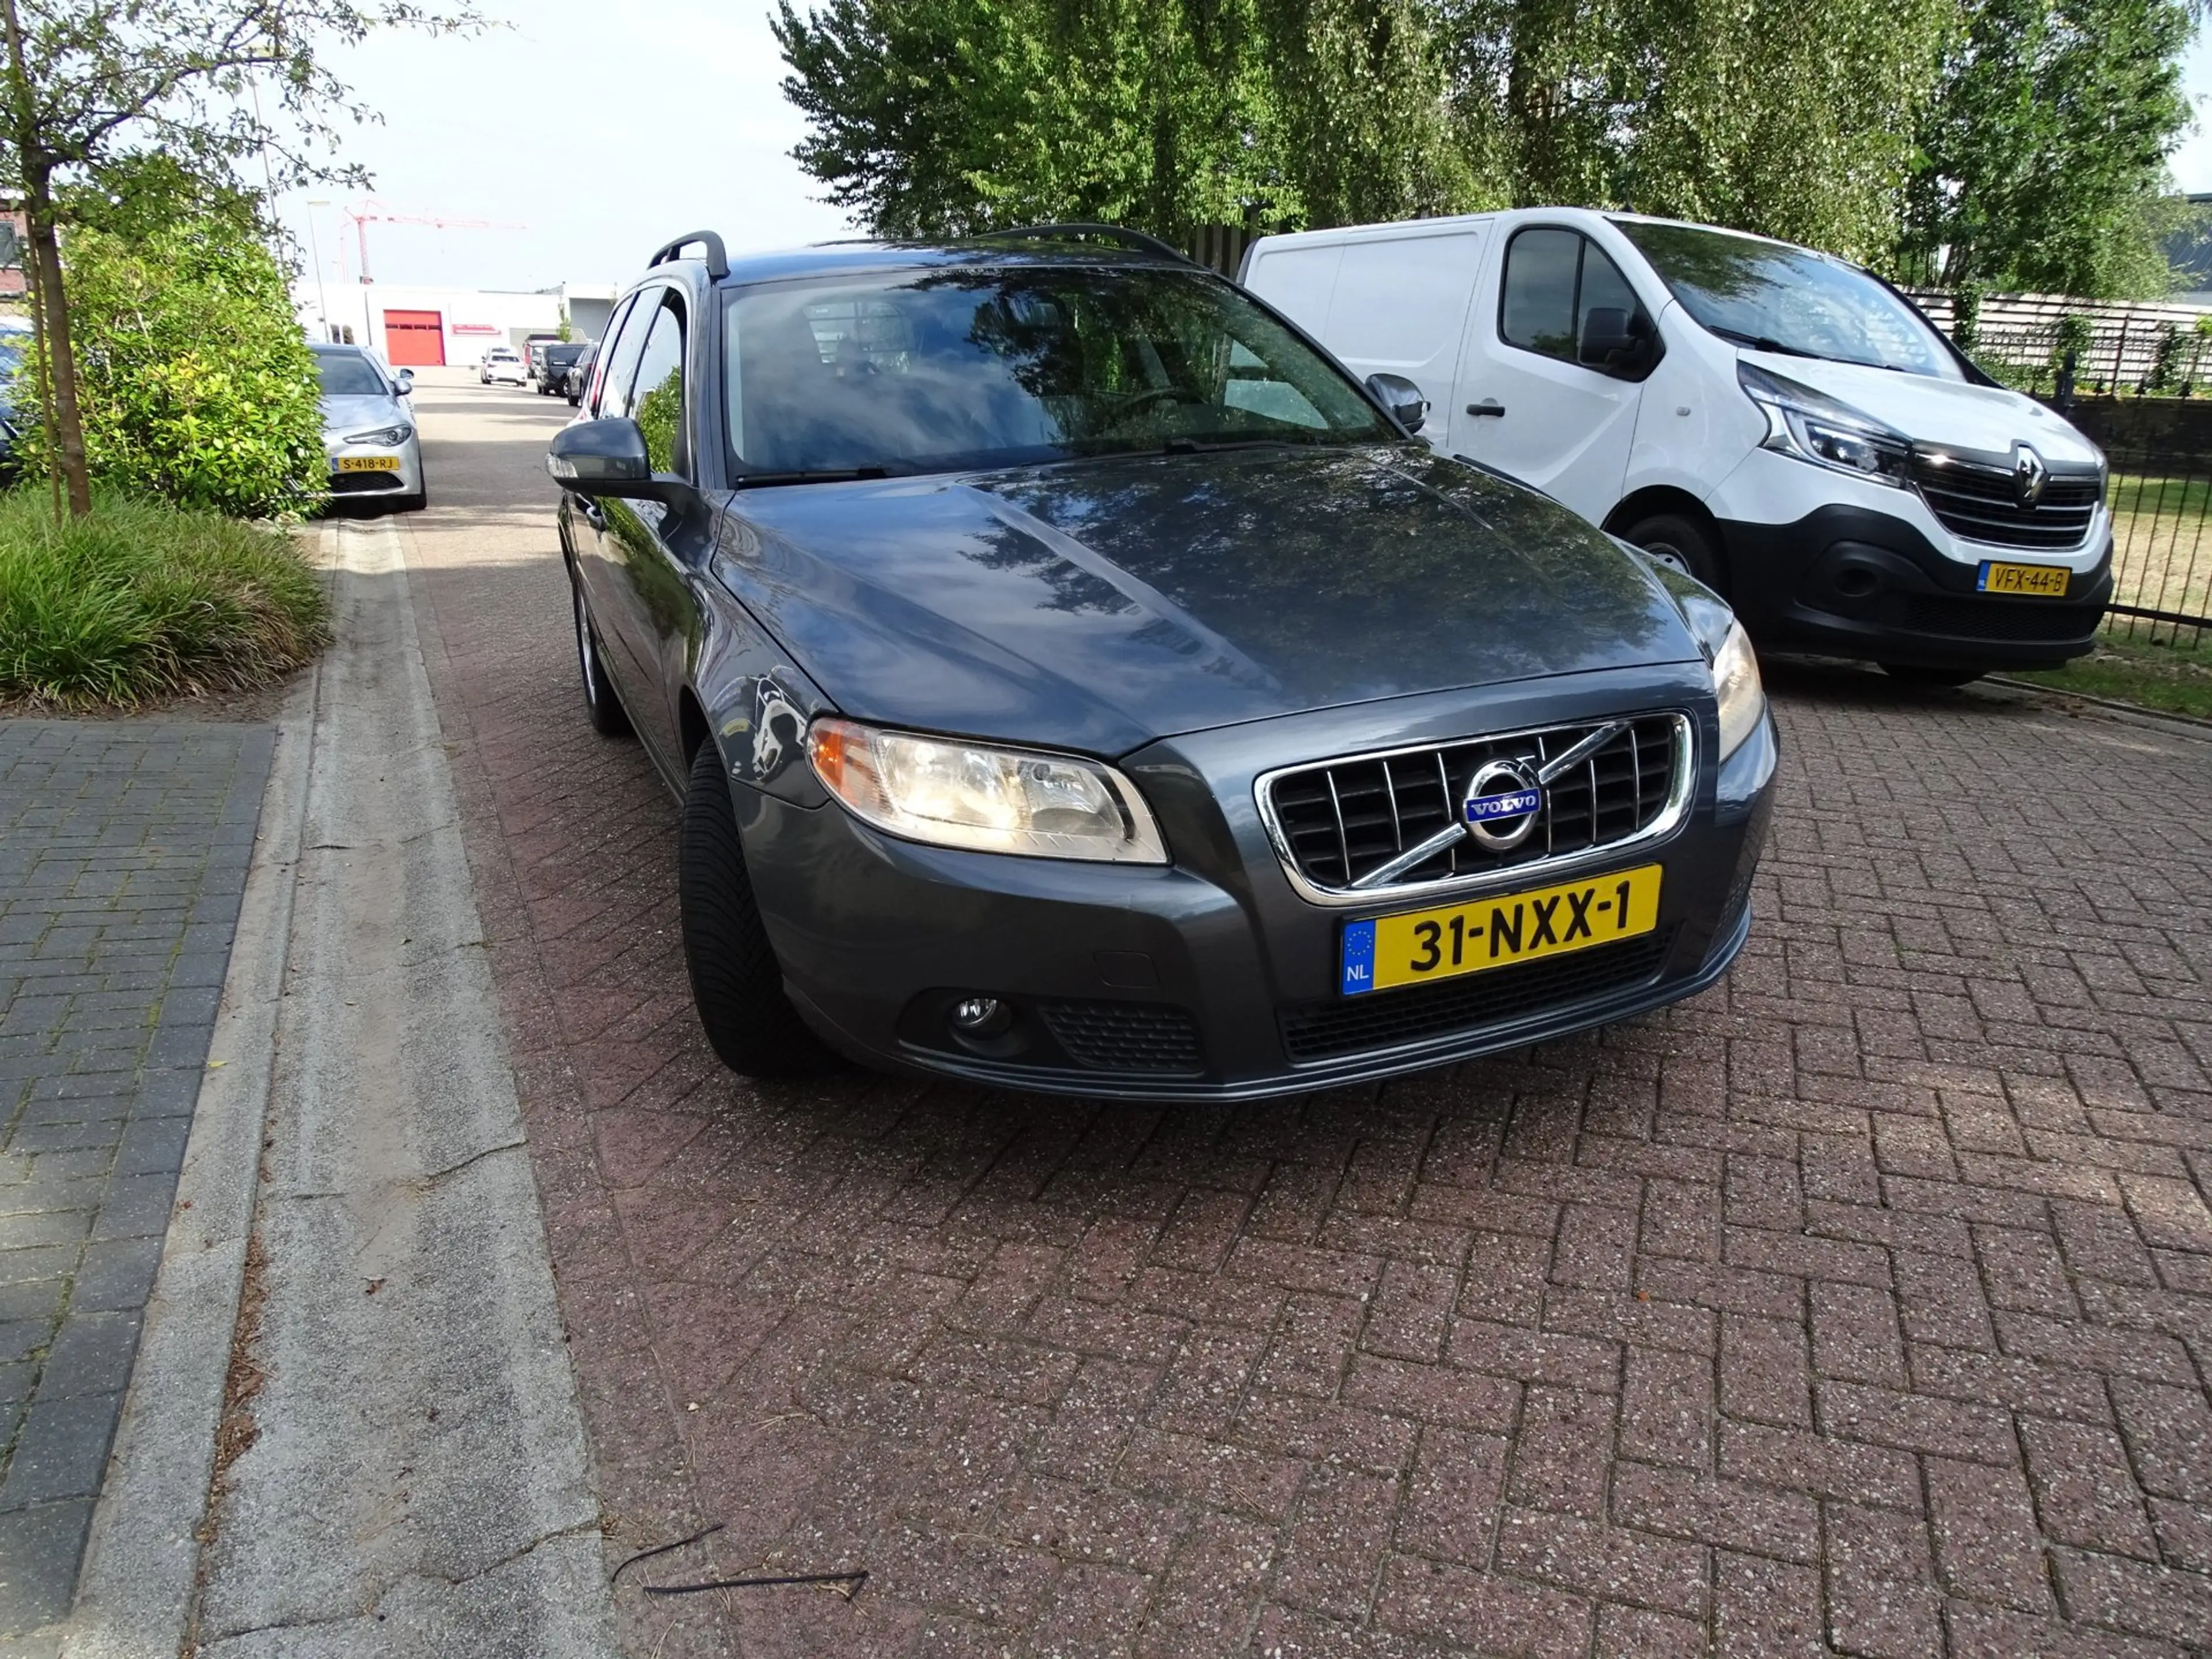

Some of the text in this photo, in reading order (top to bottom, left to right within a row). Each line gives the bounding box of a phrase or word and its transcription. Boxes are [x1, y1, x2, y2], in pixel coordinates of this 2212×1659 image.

[343, 459, 393, 469] S-418-RJ
[1995, 567, 2064, 592] VFX-44-B
[1471, 794, 1537, 816] VOLVO
[1410, 880, 1631, 972] 31-NXX-1
[1347, 964, 1369, 982] NL
